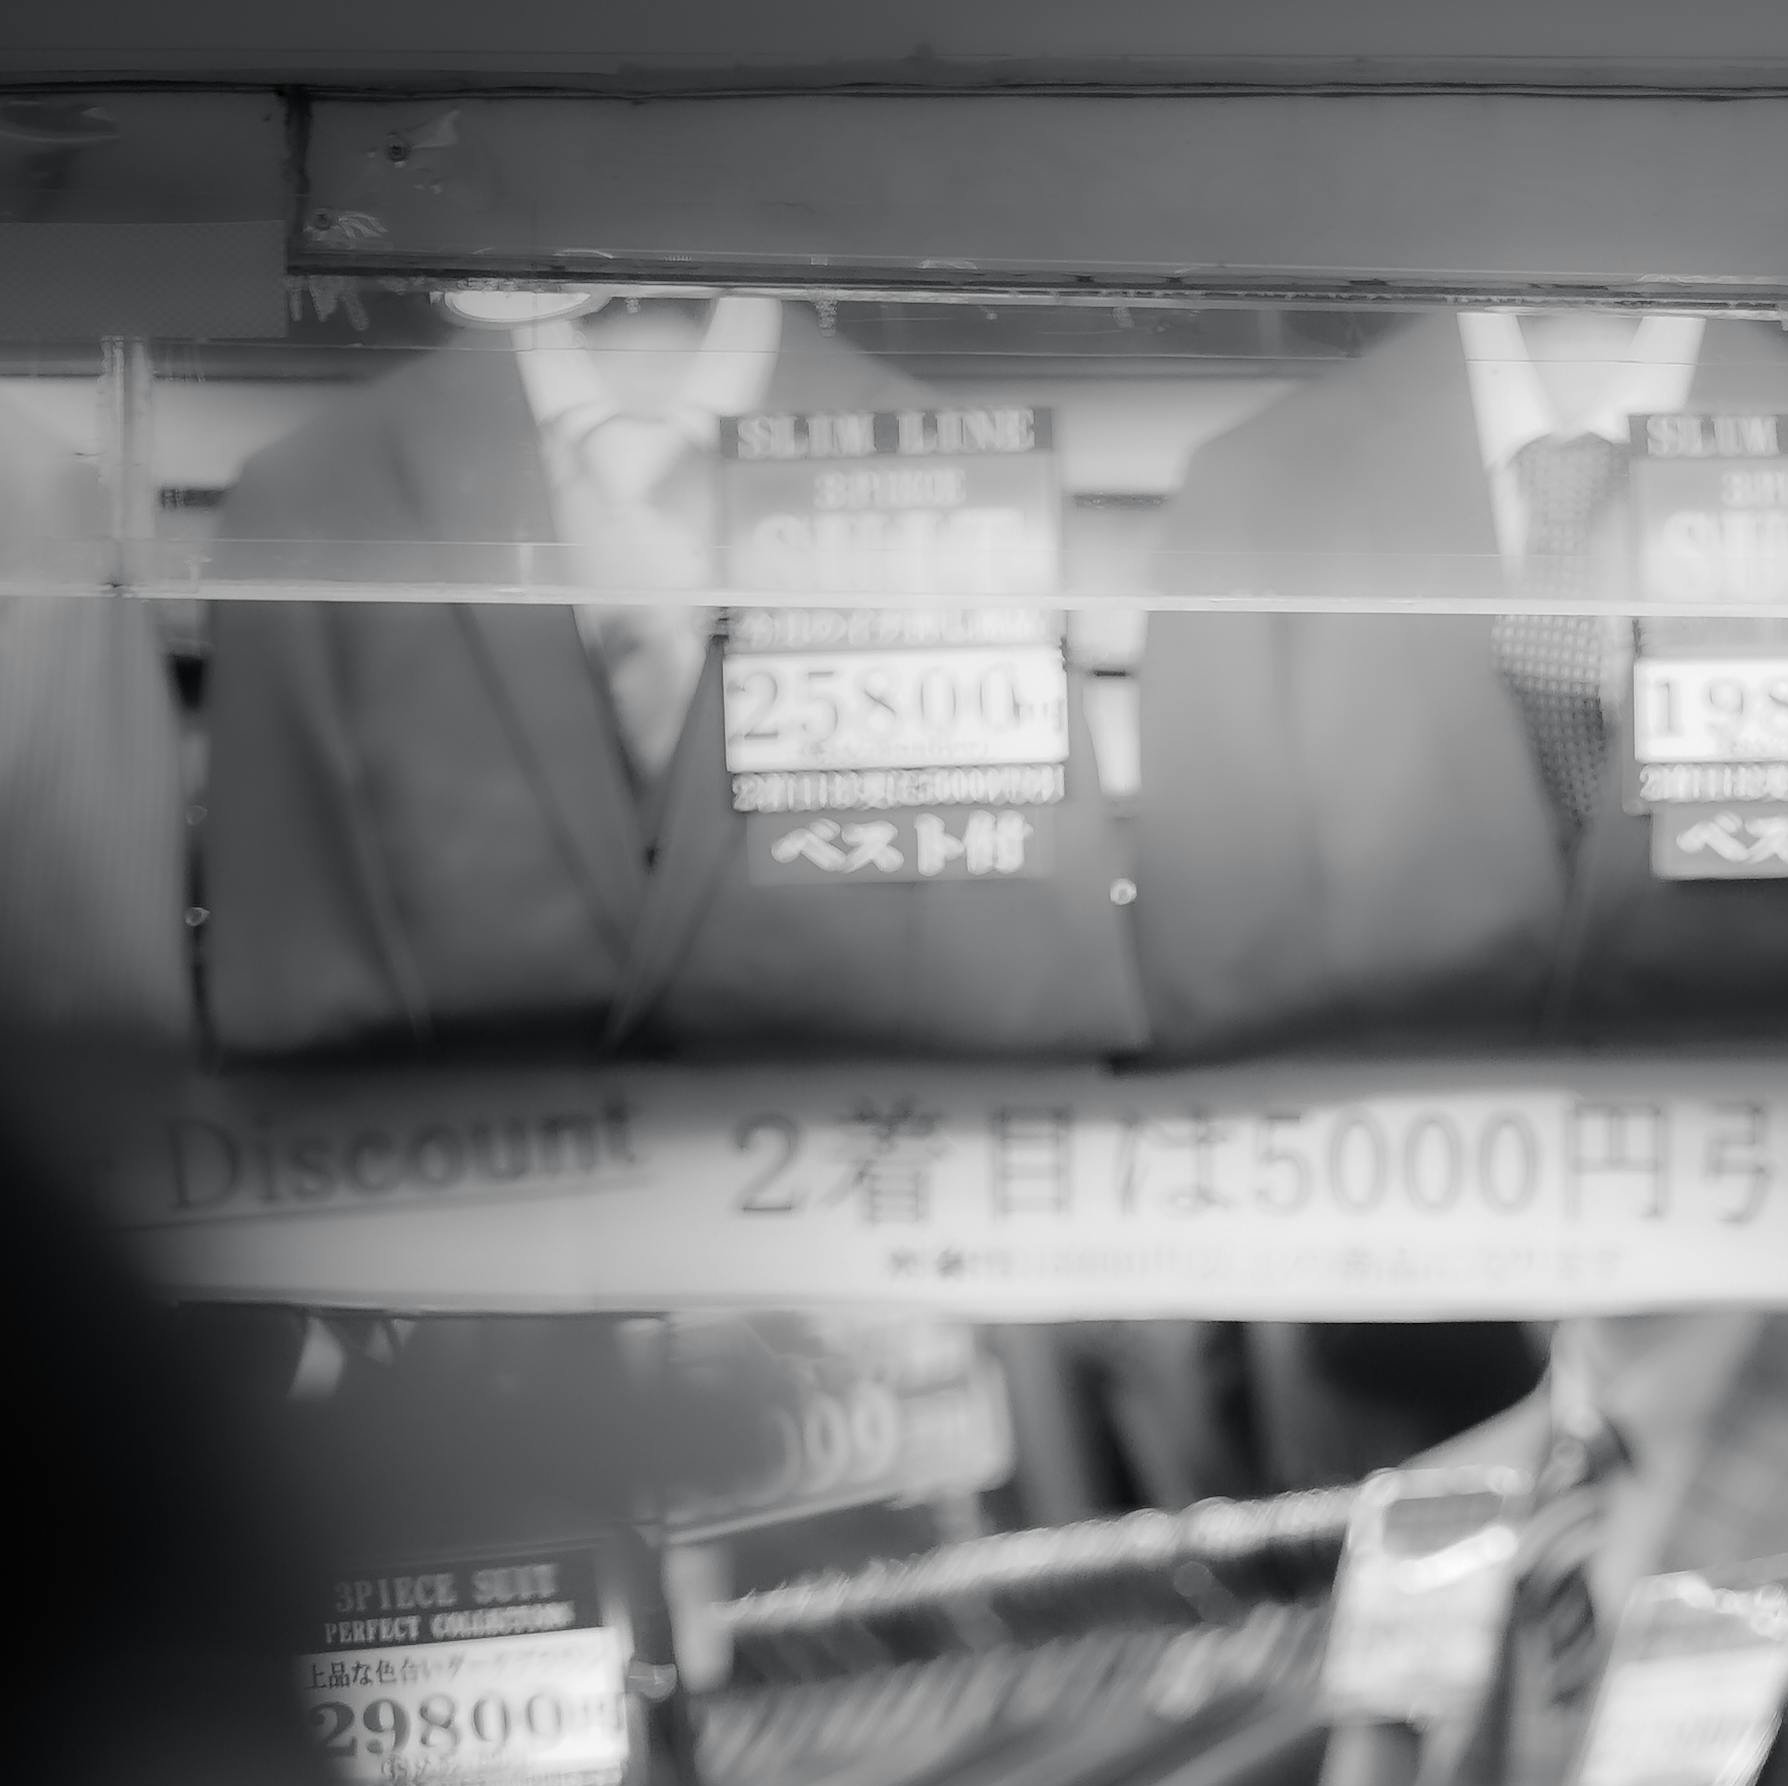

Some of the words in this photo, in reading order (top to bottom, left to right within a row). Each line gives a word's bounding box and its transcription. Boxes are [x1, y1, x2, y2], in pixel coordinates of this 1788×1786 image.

[166, 1098, 638, 1208] Discount
[324, 1614, 421, 1644] PERFECT
[306, 1692, 564, 1757] 29800
